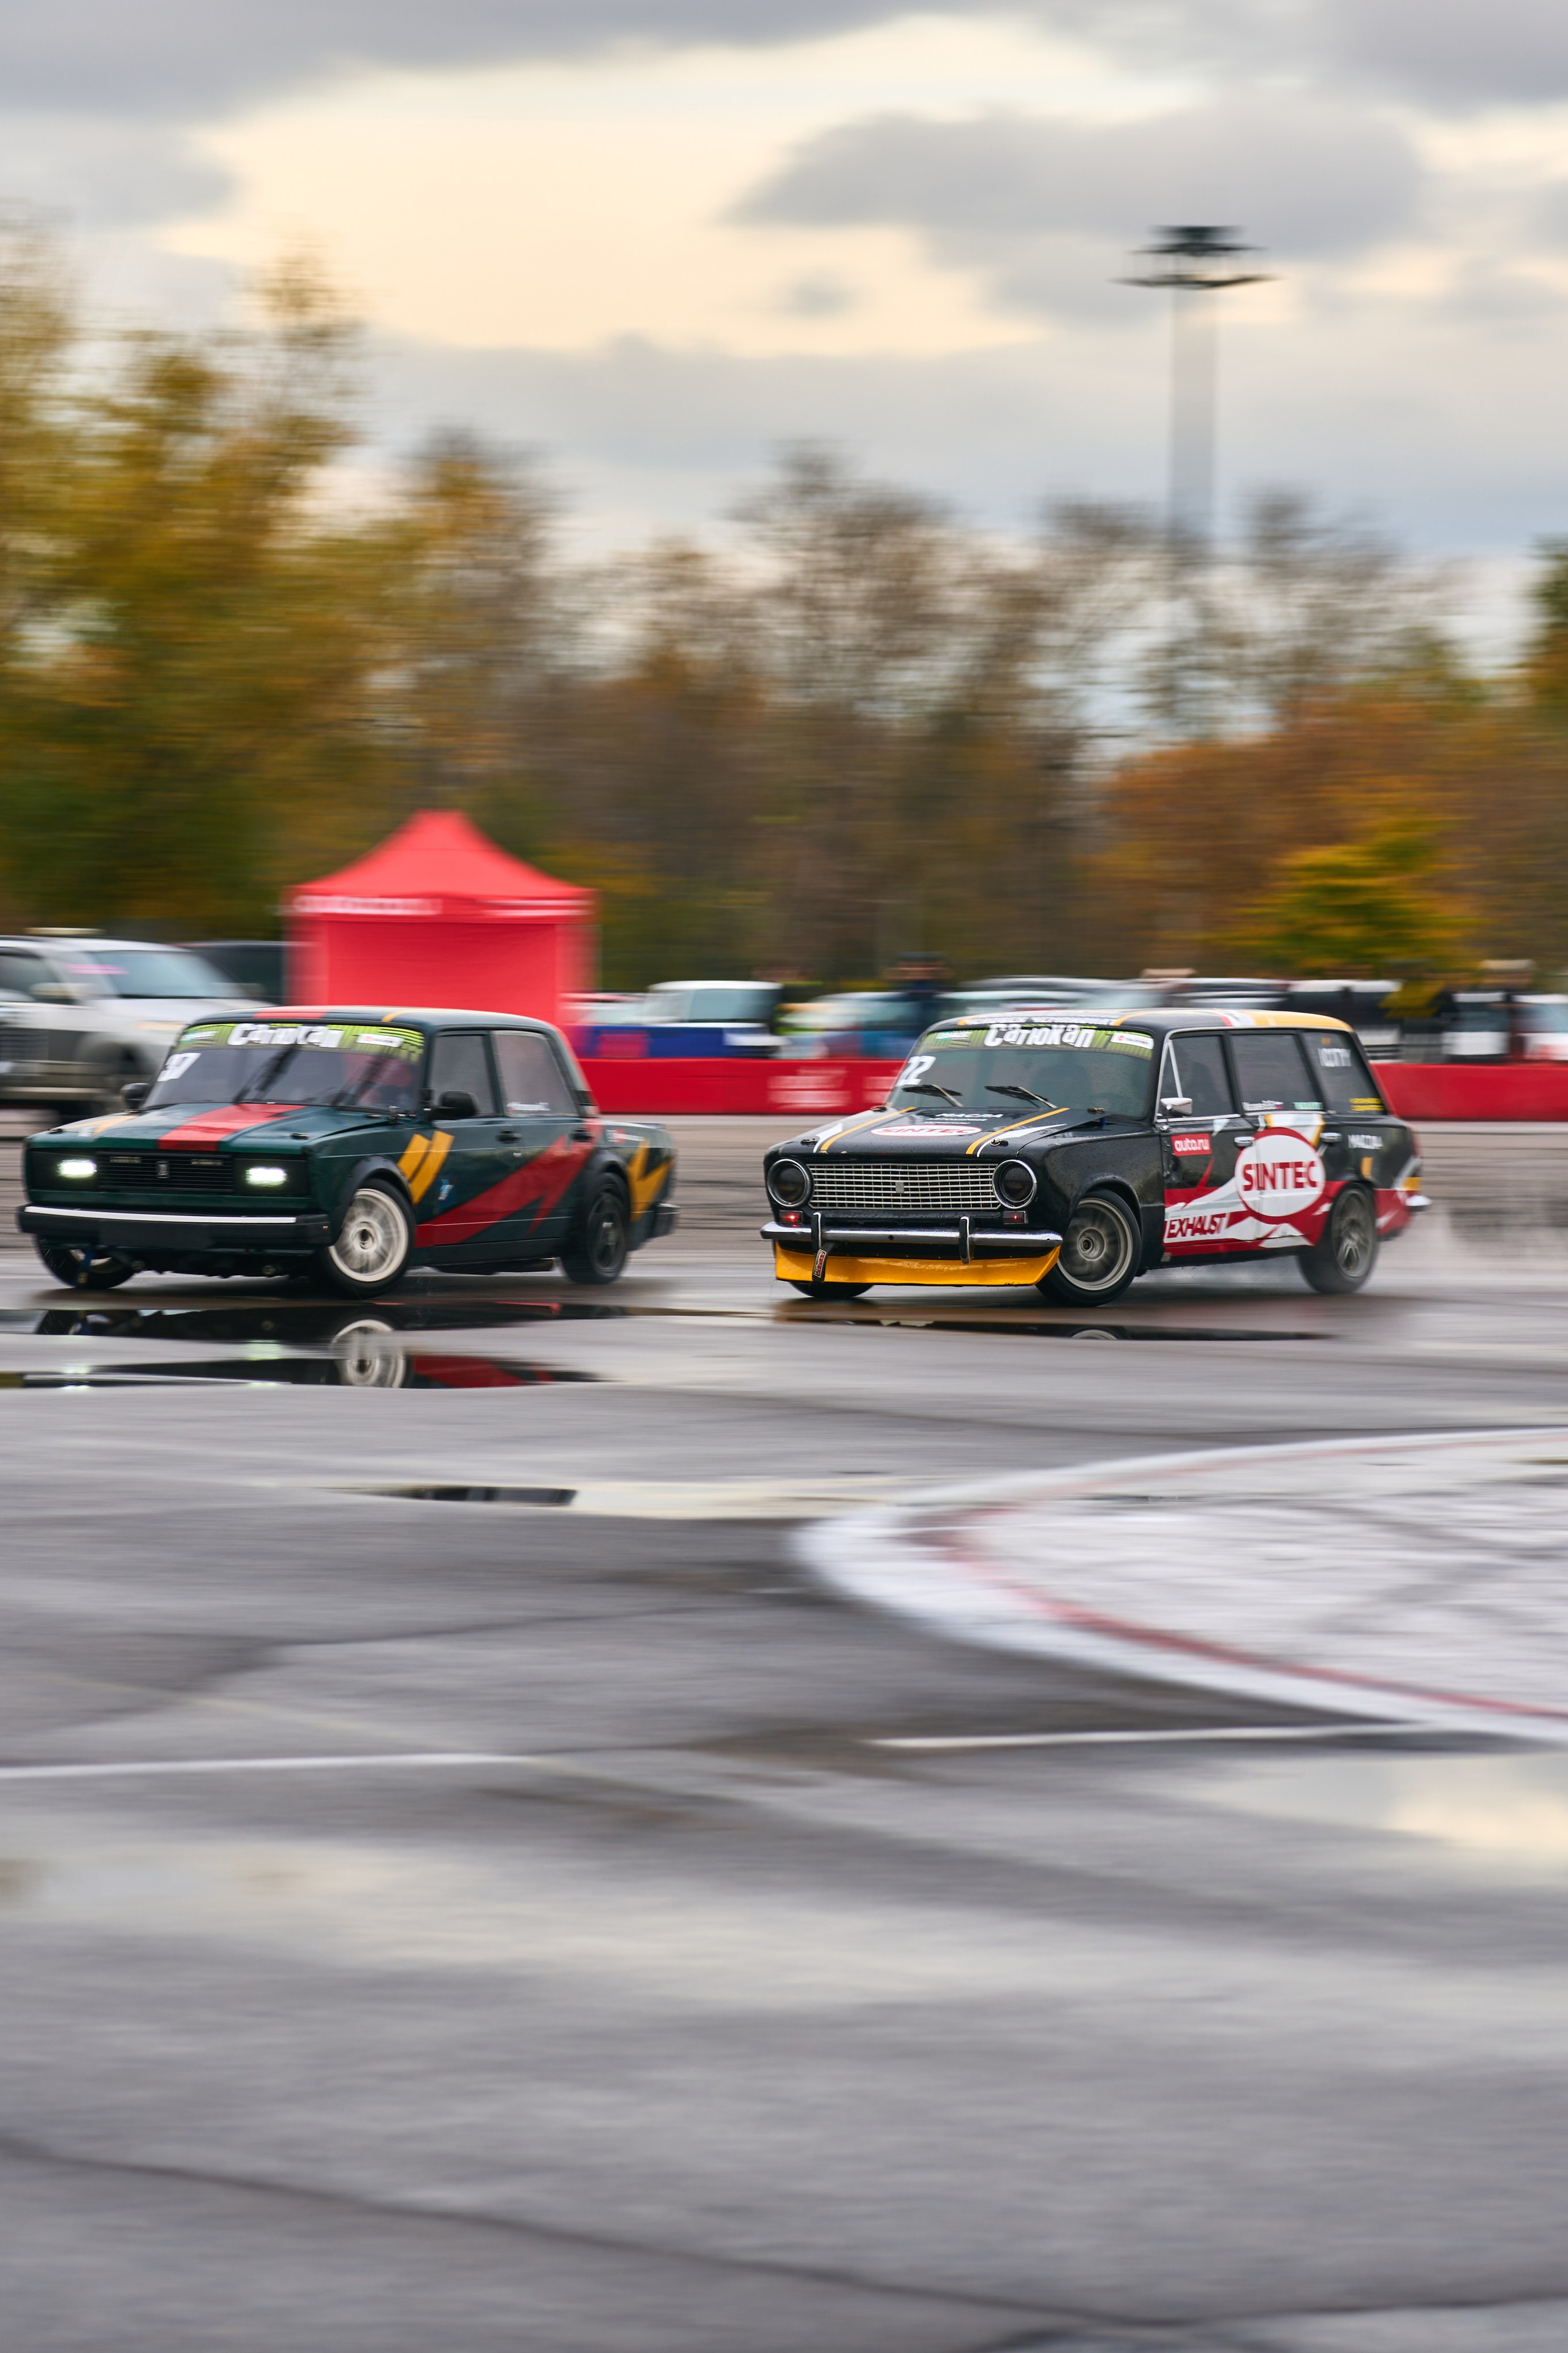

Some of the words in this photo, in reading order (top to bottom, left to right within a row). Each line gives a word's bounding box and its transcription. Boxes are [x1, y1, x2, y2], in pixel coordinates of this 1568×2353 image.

[1174, 1138, 1210, 1152] auto.ru
[1242, 1161, 1318, 1192] SINTEC
[1167, 1213, 1226, 1239] EXHAUST
